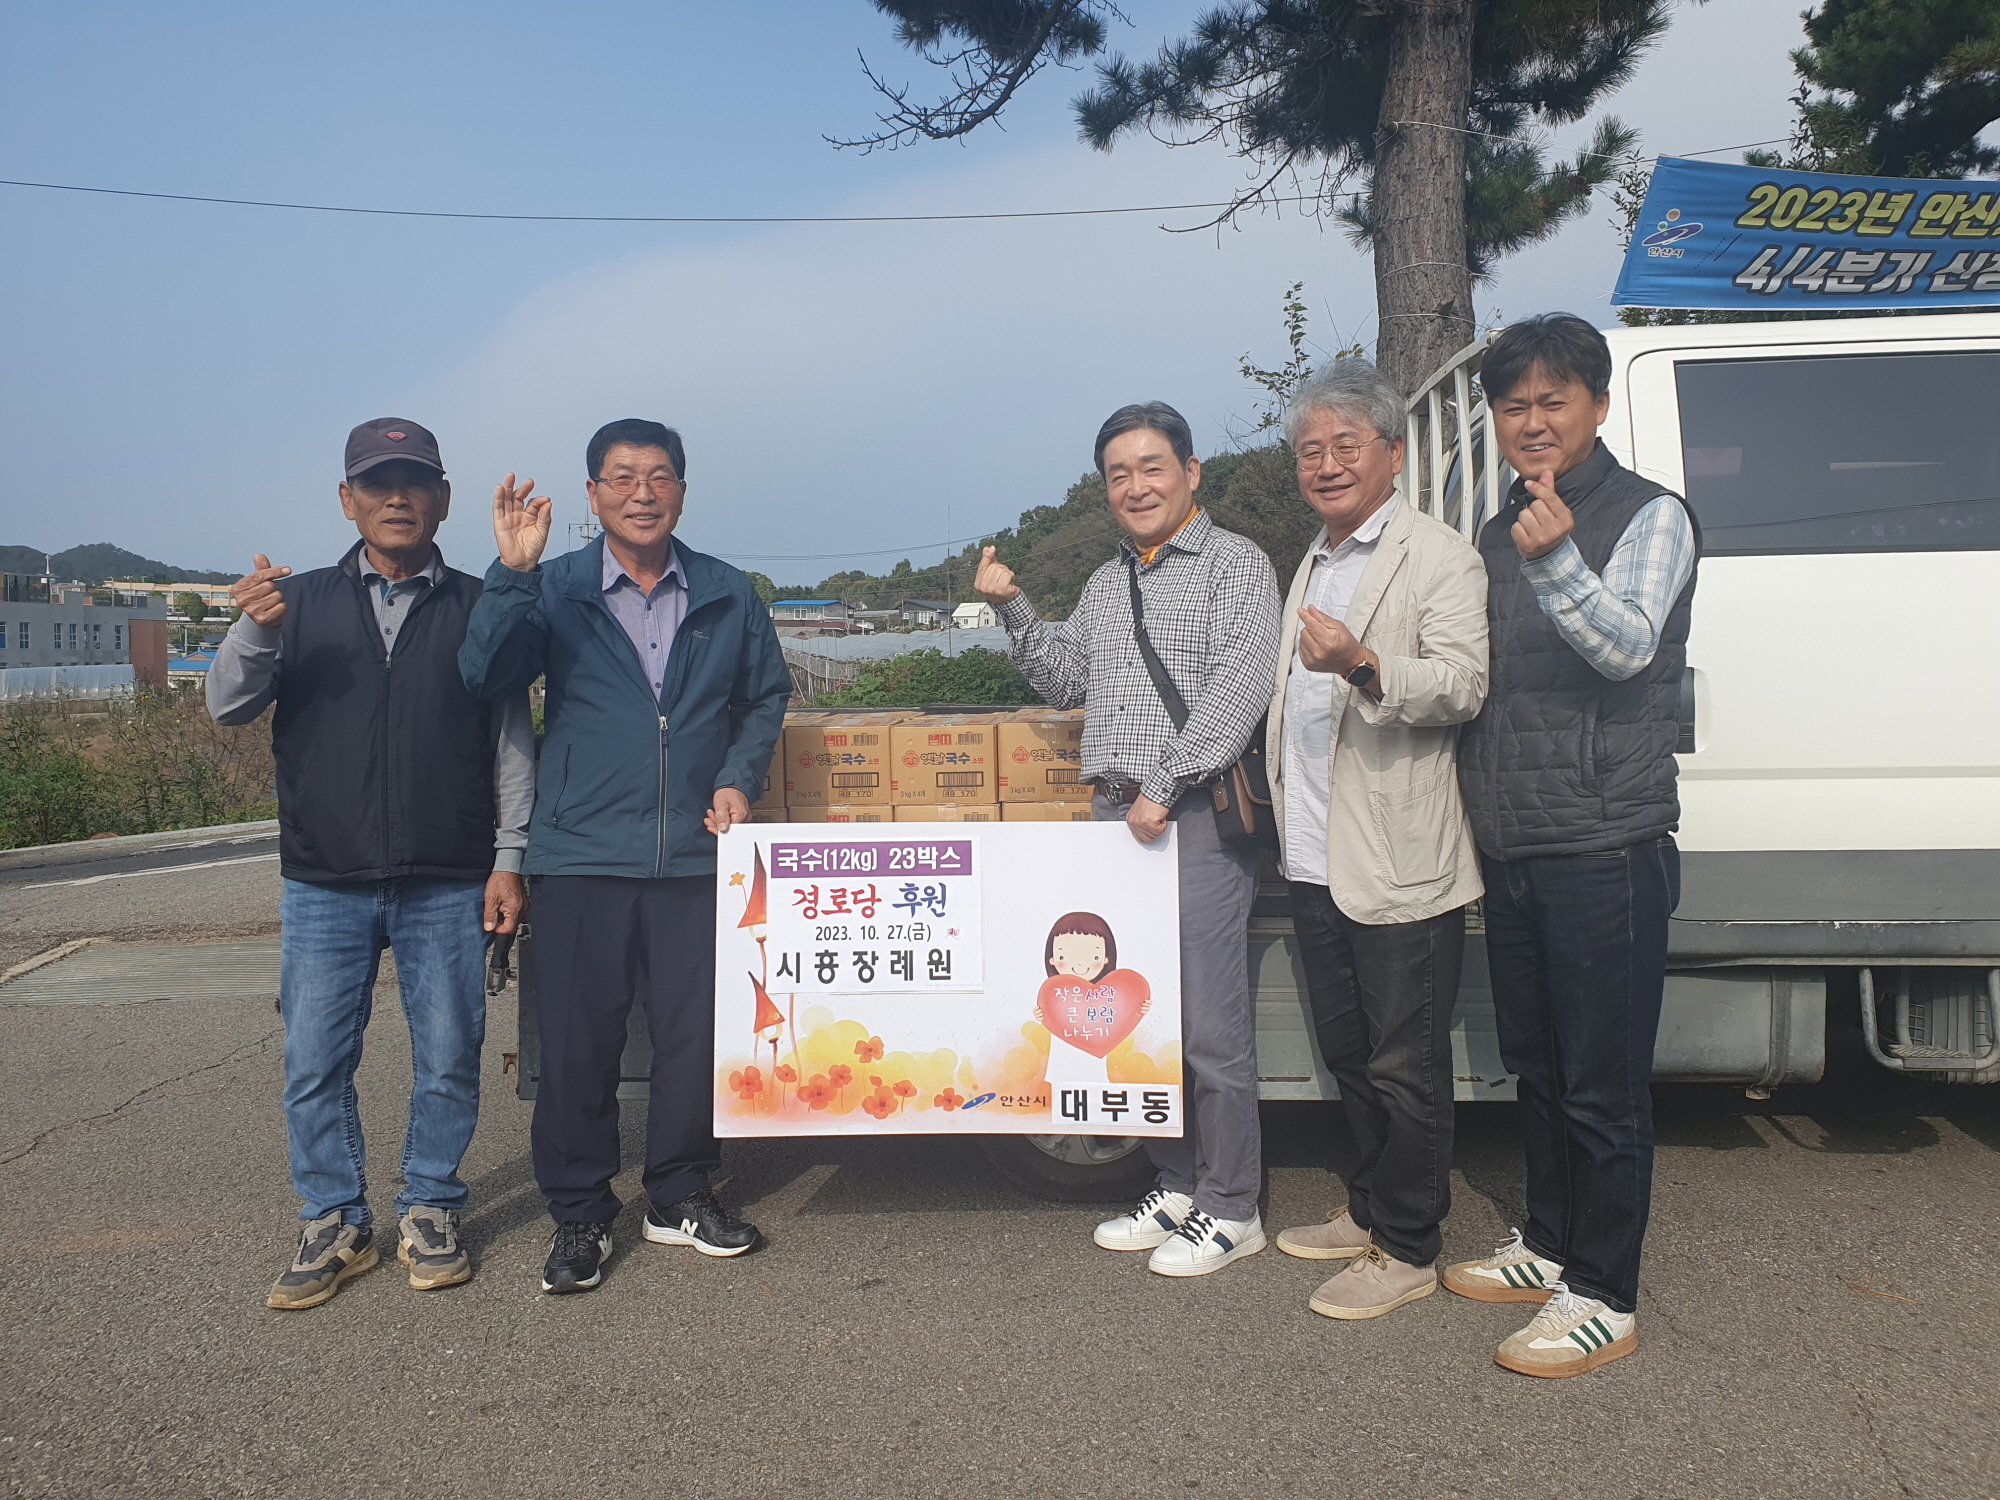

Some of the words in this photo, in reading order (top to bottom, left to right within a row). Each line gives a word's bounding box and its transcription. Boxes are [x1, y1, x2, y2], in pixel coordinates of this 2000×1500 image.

[1735, 184, 1915, 236] 2023년
[1908, 192, 2000, 237] 안산
[1648, 246, 1684, 258] 안산시
[1735, 246, 1933, 293] 4/4분기
[777, 848, 878, 872] 국수(12kg)
[889, 846, 961, 870] 23박스
[792, 883, 882, 920] 경로당
[892, 882, 947, 918] 후원
[815, 926, 852, 941] 2023.
[860, 925, 879, 940] 10.
[1054, 986, 1083, 1003] 작은
[1085, 985, 1116, 1004] 사랑
[1066, 1006, 1079, 1023] 큰
[1085, 1005, 1116, 1024] 보람
[1063, 1025, 1110, 1041] 나누기
[1000, 1095, 1046, 1107] 안산시
